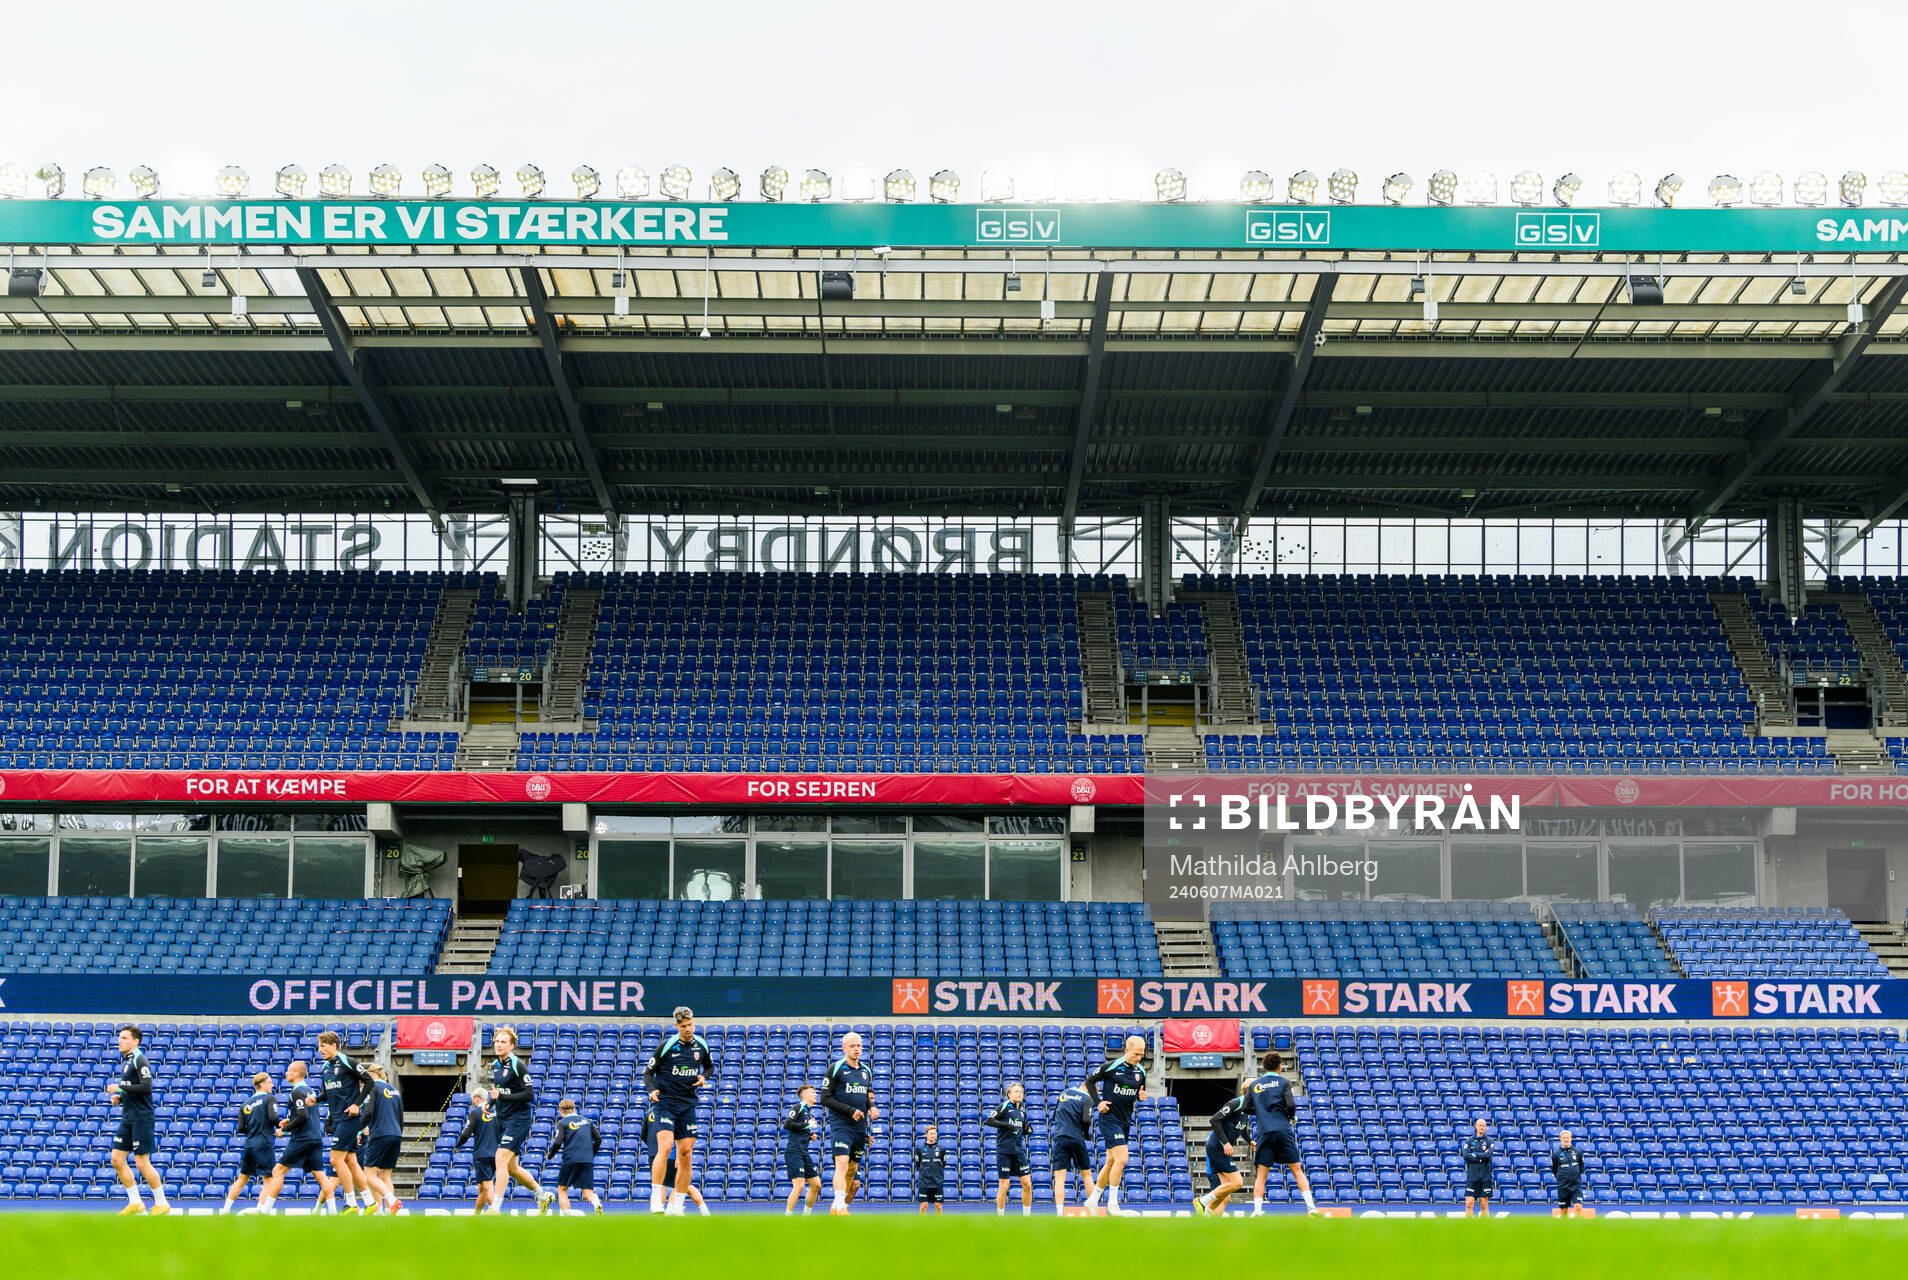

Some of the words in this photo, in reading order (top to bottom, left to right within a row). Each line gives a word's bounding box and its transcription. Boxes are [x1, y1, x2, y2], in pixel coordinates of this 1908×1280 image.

[92, 205, 311, 240] SAMMEN
[324, 206, 387, 240] ER
[399, 207, 445, 240] VI
[455, 206, 729, 241] STÆRKERE
[982, 219, 1054, 239] GSV
[1252, 221, 1325, 241] GSV
[1522, 223, 1595, 243] GSV
[1815, 218, 1908, 242] SAMM
[519, 672, 532, 681] 20
[1179, 675, 1192, 683] 21
[1839, 677, 1851, 685] 22
[186, 779, 229, 795] FOR
[233, 780, 261, 795] AT
[266, 779, 346, 795] KÆMPE
[747, 780, 790, 797] FOR
[795, 780, 876, 797] SEJREN
[1247, 783, 1289, 798] FOR
[1295, 783, 1322, 798] AT
[1327, 780, 1364, 798] STÅ
[1371, 783, 1463, 799] SAMMEN
[1831, 784, 1872, 800] FOR
[1880, 784, 1908, 800] HO
[386, 849, 399, 858] 20
[577, 850, 589, 859] 20
[1072, 851, 1085, 860] 21
[249, 979, 439, 1012] OFFICIEL
[451, 981, 645, 1013] PARTNER
[933, 981, 1063, 1013] STARK
[1138, 982, 1267, 1013] STARK
[1344, 982, 1473, 1014] STARK
[1549, 983, 1678, 1014] STARK
[1754, 984, 1882, 1015] STARK
